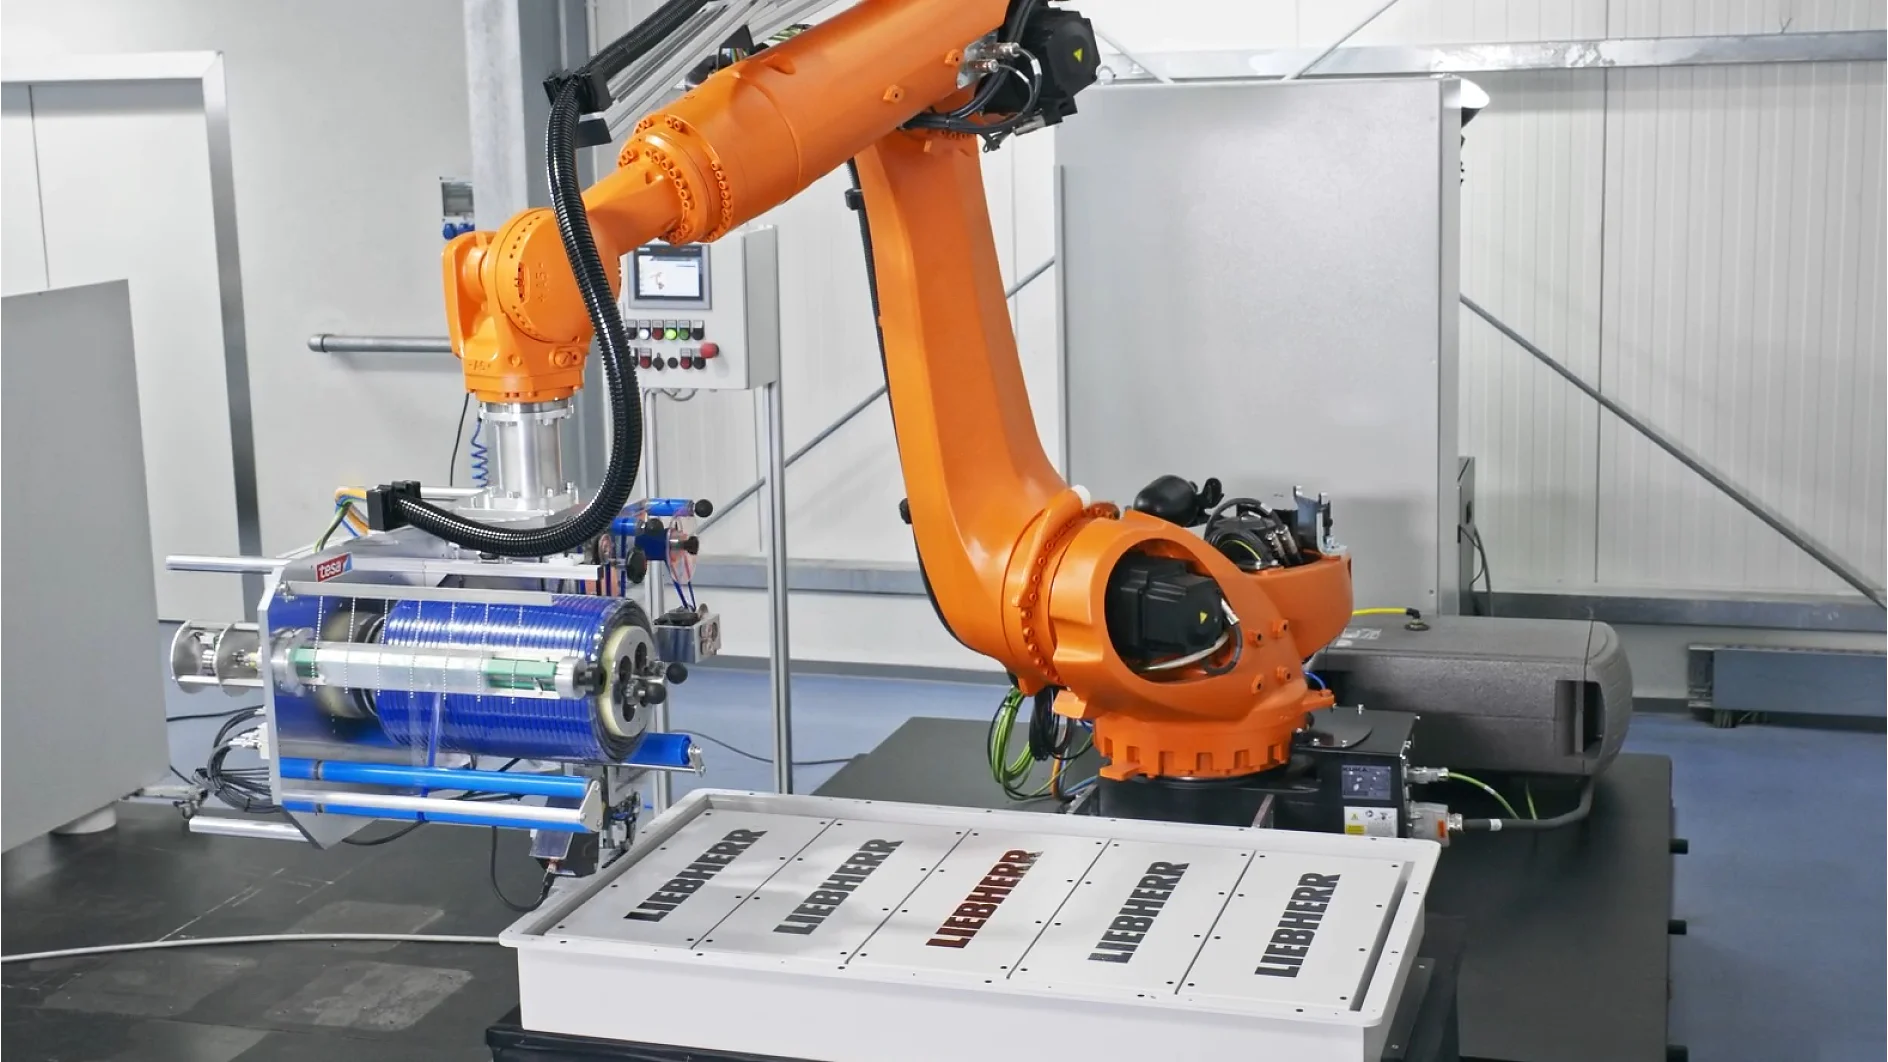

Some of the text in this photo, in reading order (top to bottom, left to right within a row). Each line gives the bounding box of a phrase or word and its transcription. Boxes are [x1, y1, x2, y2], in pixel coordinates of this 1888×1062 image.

[319, 561, 341, 578] tesa
[623, 829, 768, 922] LIEBHERR
[773, 838, 904, 935] LIEBHERR
[926, 849, 1044, 949] LIEBHERR
[1087, 861, 1190, 964] LIEBHERR
[1254, 872, 1341, 978] LIEBHERR
